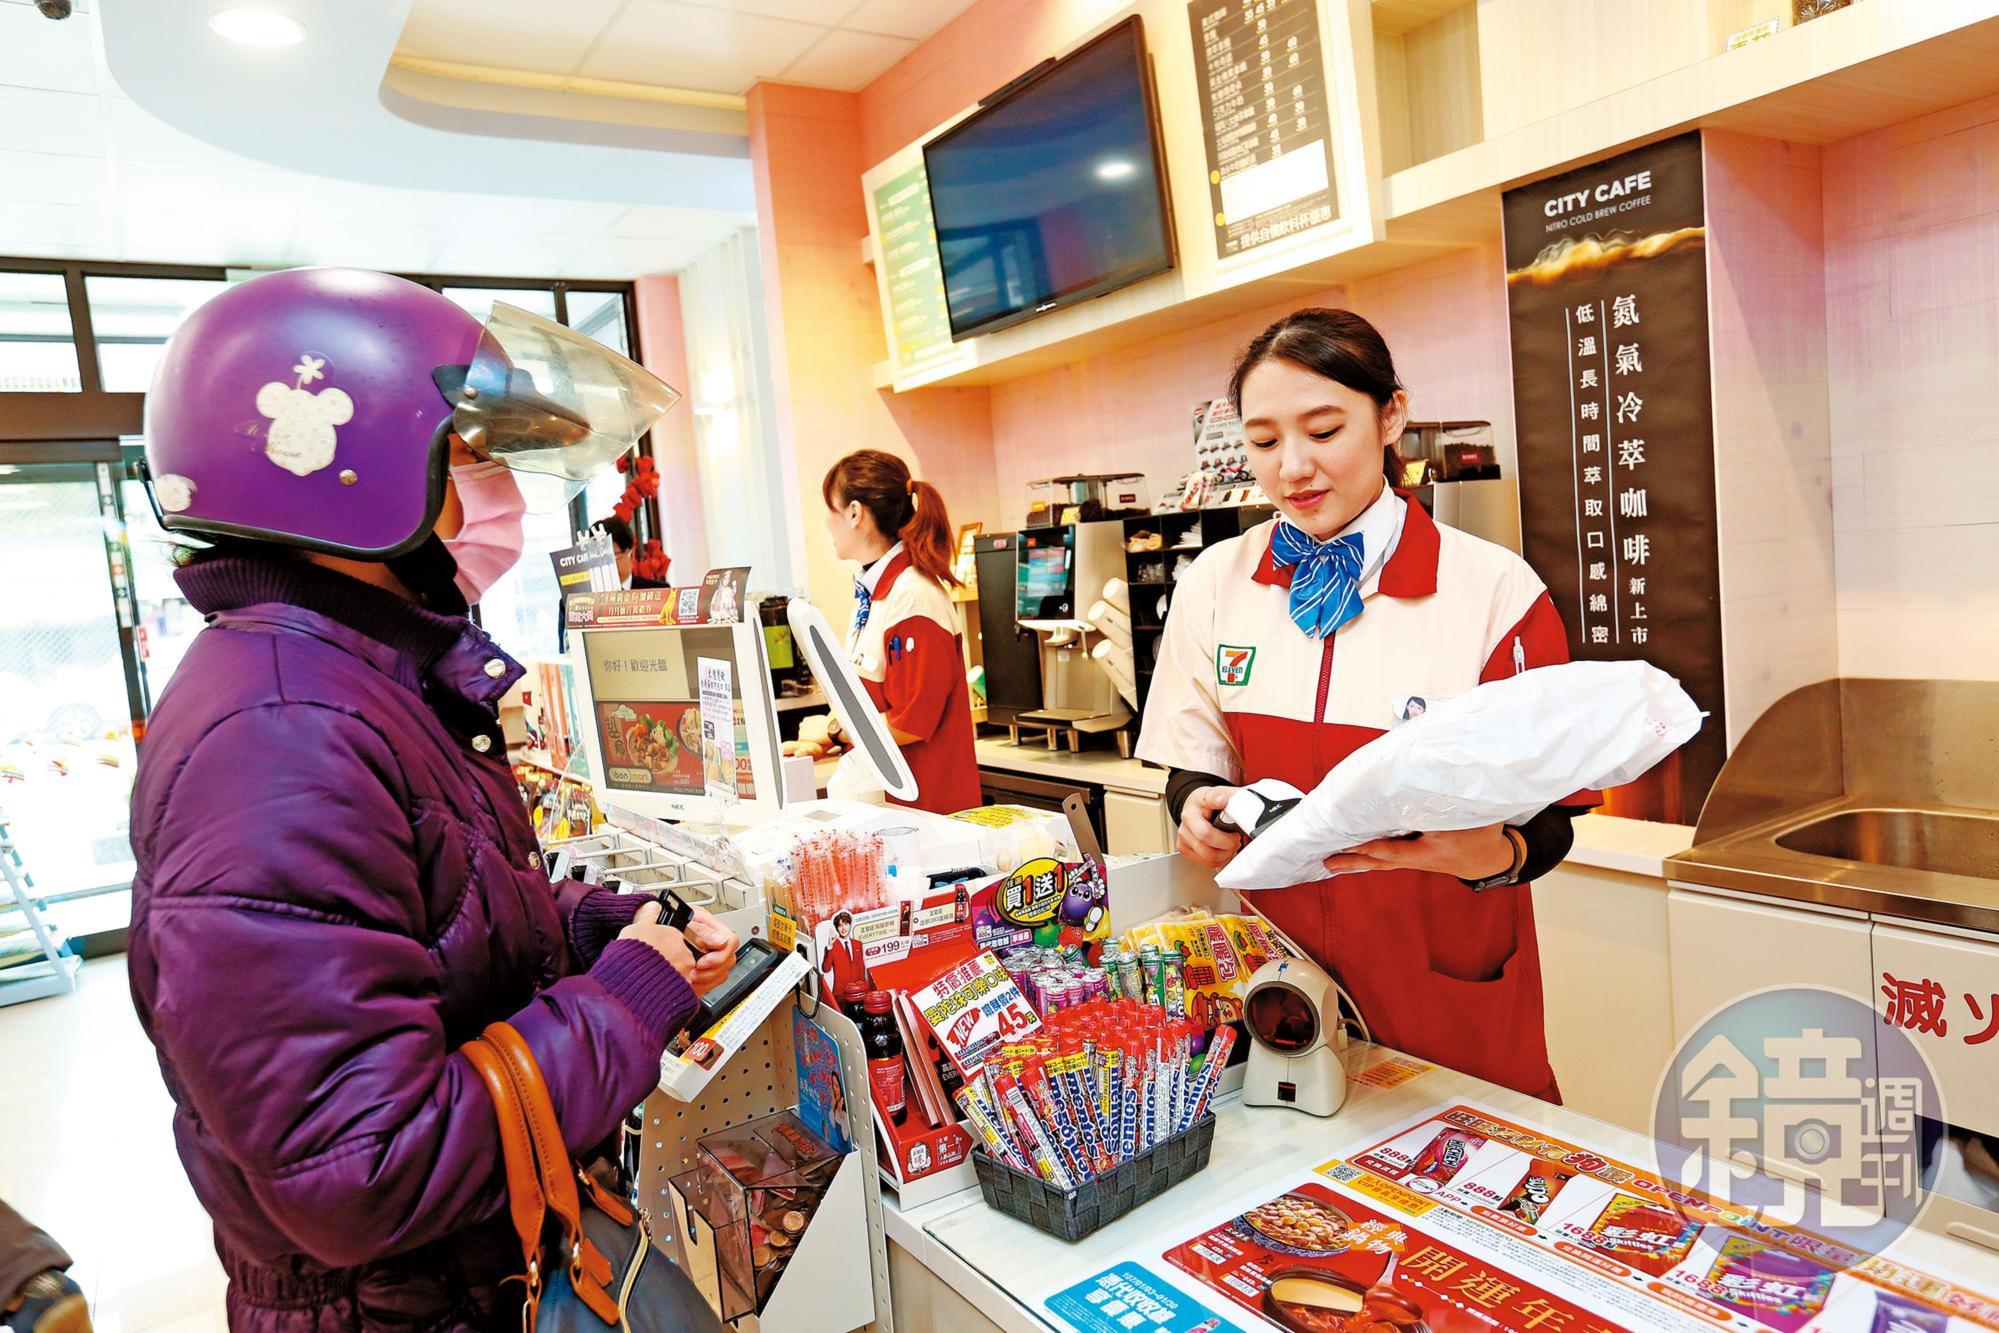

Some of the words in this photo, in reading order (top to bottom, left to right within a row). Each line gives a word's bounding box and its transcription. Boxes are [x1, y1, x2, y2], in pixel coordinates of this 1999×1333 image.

[1544, 189, 1590, 217] CITY
[1594, 170, 1652, 202] CAFE
[1545, 219, 1568, 233] NITRO
[1569, 212, 1593, 226] COLD
[1594, 205, 1617, 219] BREW
[1619, 195, 1651, 213] COFFEE
[1611, 294, 1650, 566] 氮氣冷萃咖啡
[1575, 303, 1609, 644] 低溫長時間萃取口感綿密
[559, 555, 577, 567] CITY
[1628, 577, 1649, 645] 新上市
[1225, 650, 1249, 683] 7
[671, 803, 687, 811] NEC
[881, 940, 900, 953] 199
[923, 965, 1009, 1027] 曼陀珠可樂口味
[932, 959, 984, 999] 特價推薦
[953, 1010, 976, 1042] NEW
[997, 1002, 1028, 1038] 45
[1064, 1071, 1099, 1159] mentos
[1145, 1081, 1156, 1146] entos
[1436, 1189, 1462, 1203] APP
[1400, 1245, 1616, 1333] 開運年
